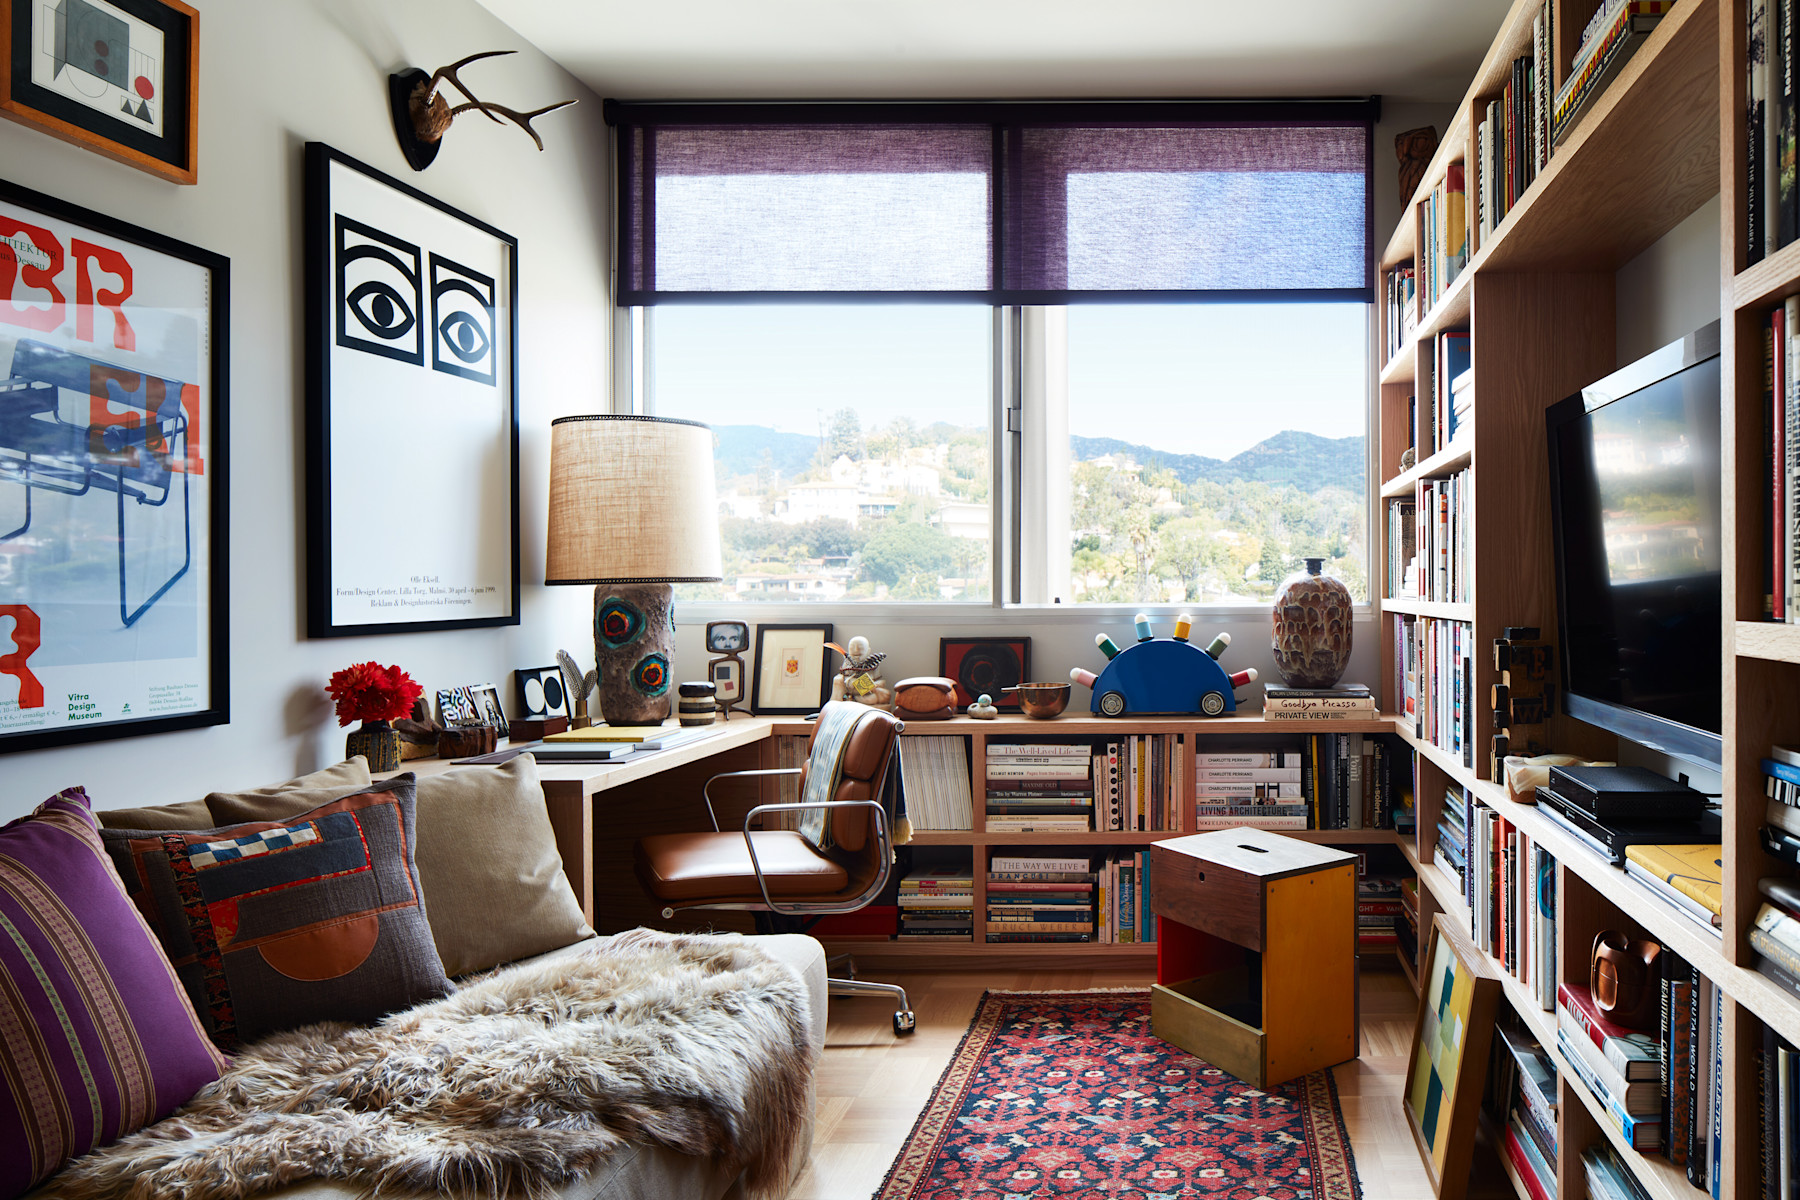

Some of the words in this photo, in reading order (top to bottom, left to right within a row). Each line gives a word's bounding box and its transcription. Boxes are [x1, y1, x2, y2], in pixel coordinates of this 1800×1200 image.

[14, 254, 45, 270] Dessau
[68, 703, 96, 711] Design
[1281, 699, 1316, 710] Goodbye
[1322, 698, 1356, 708] Picasso
[68, 712, 102, 720] Museum
[1350, 755, 1360, 781] Ponti
[1201, 807, 1229, 815] LIVING
[1229, 807, 1287, 815] ARCHITECTURE
[1003, 862, 1020, 870] THE
[1023, 862, 1041, 870] WAY
[1043, 862, 1056, 870] WE
